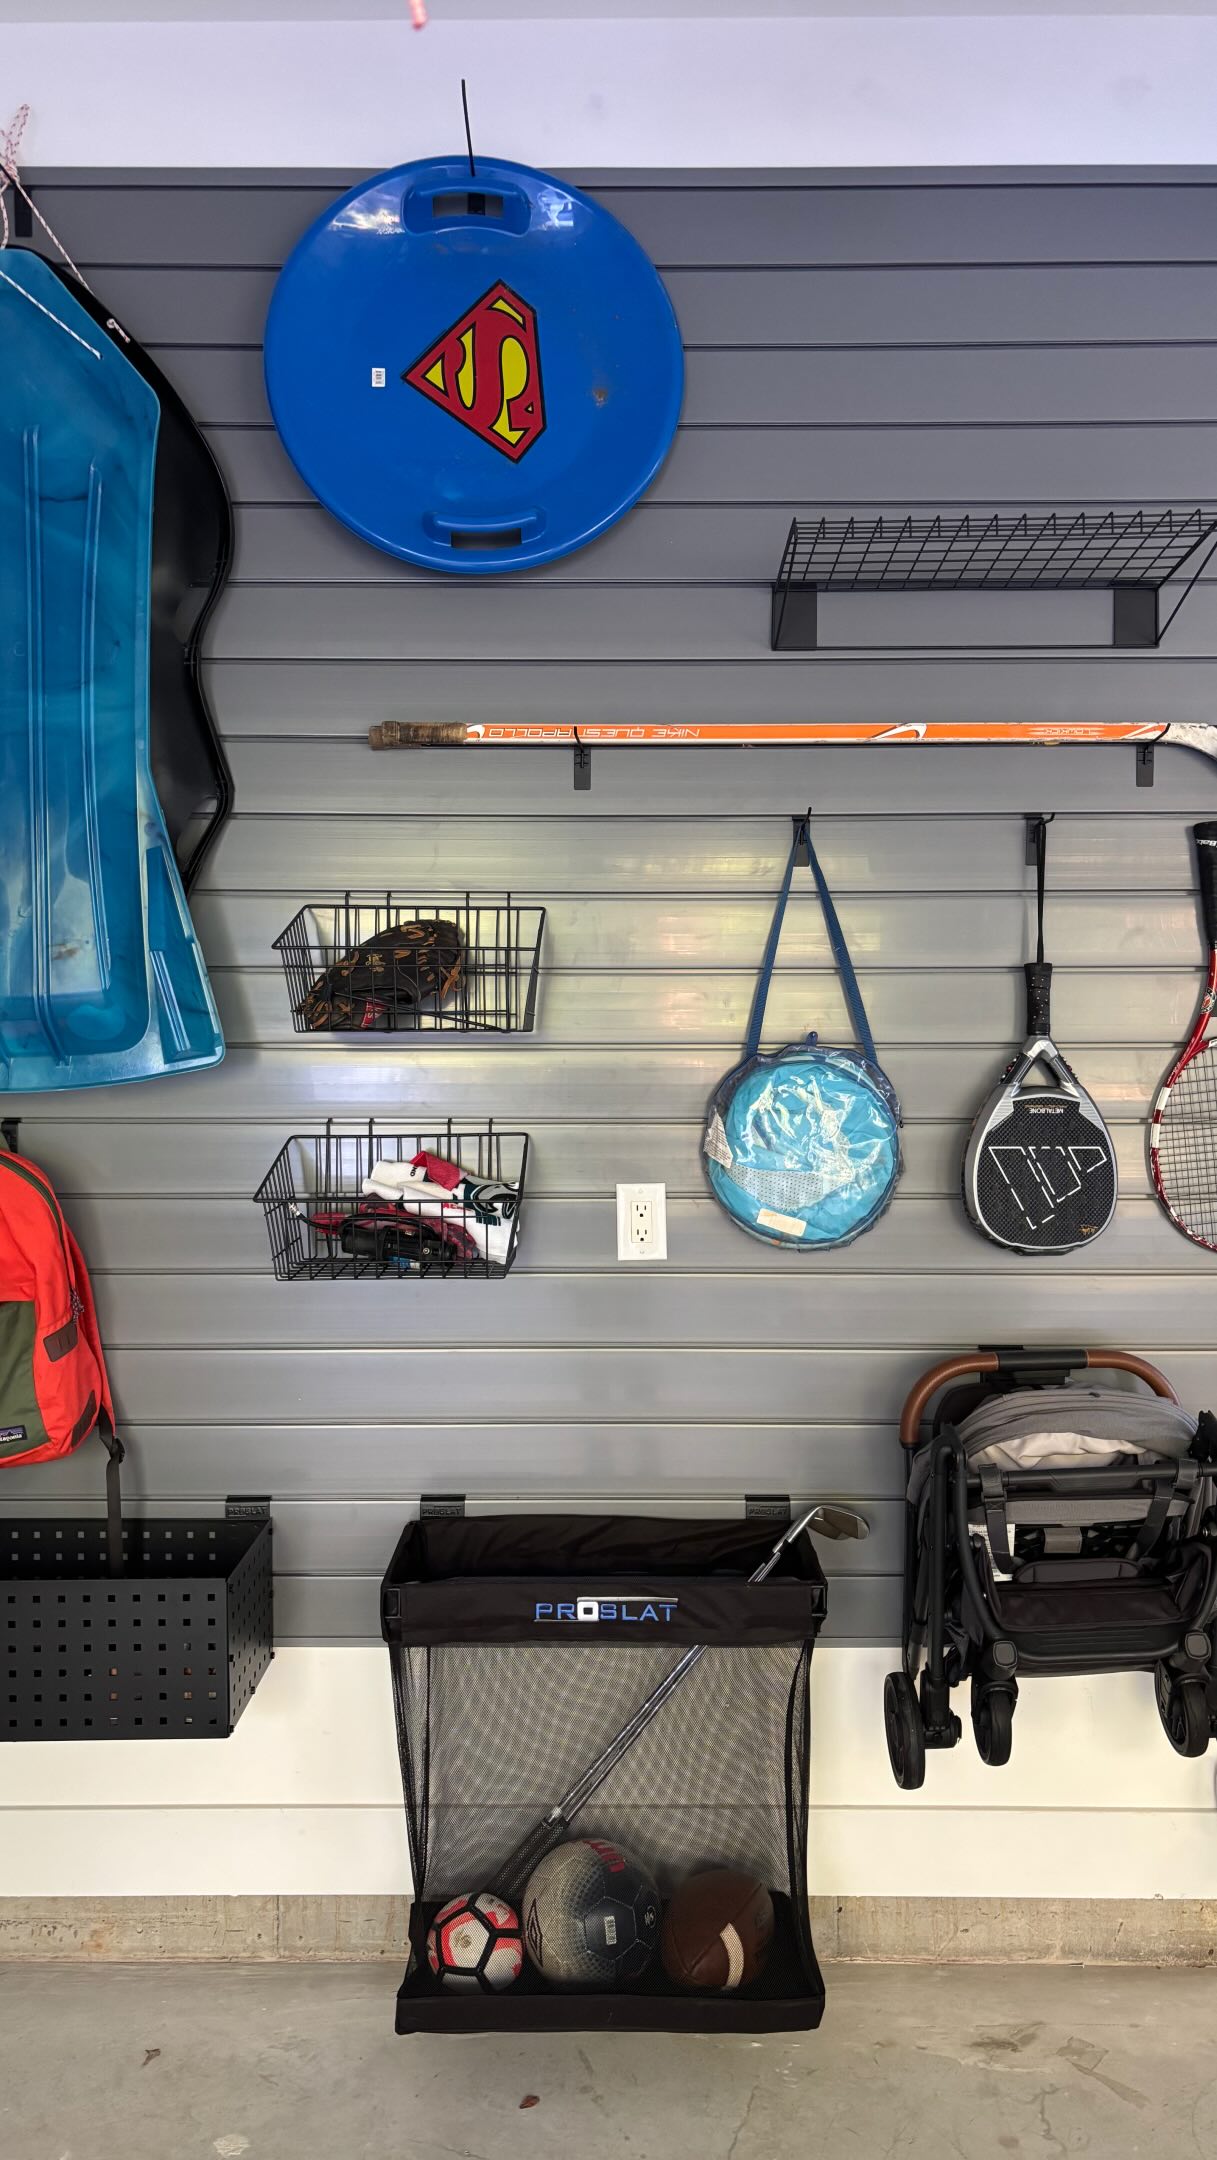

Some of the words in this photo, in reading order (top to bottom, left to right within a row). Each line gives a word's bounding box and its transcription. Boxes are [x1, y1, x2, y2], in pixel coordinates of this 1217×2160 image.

[488, 728, 572, 738] APOLLO
[577, 726, 645, 738] QUEST
[652, 727, 700, 738] NIKE
[534, 1599, 678, 1622] PROSLAT
